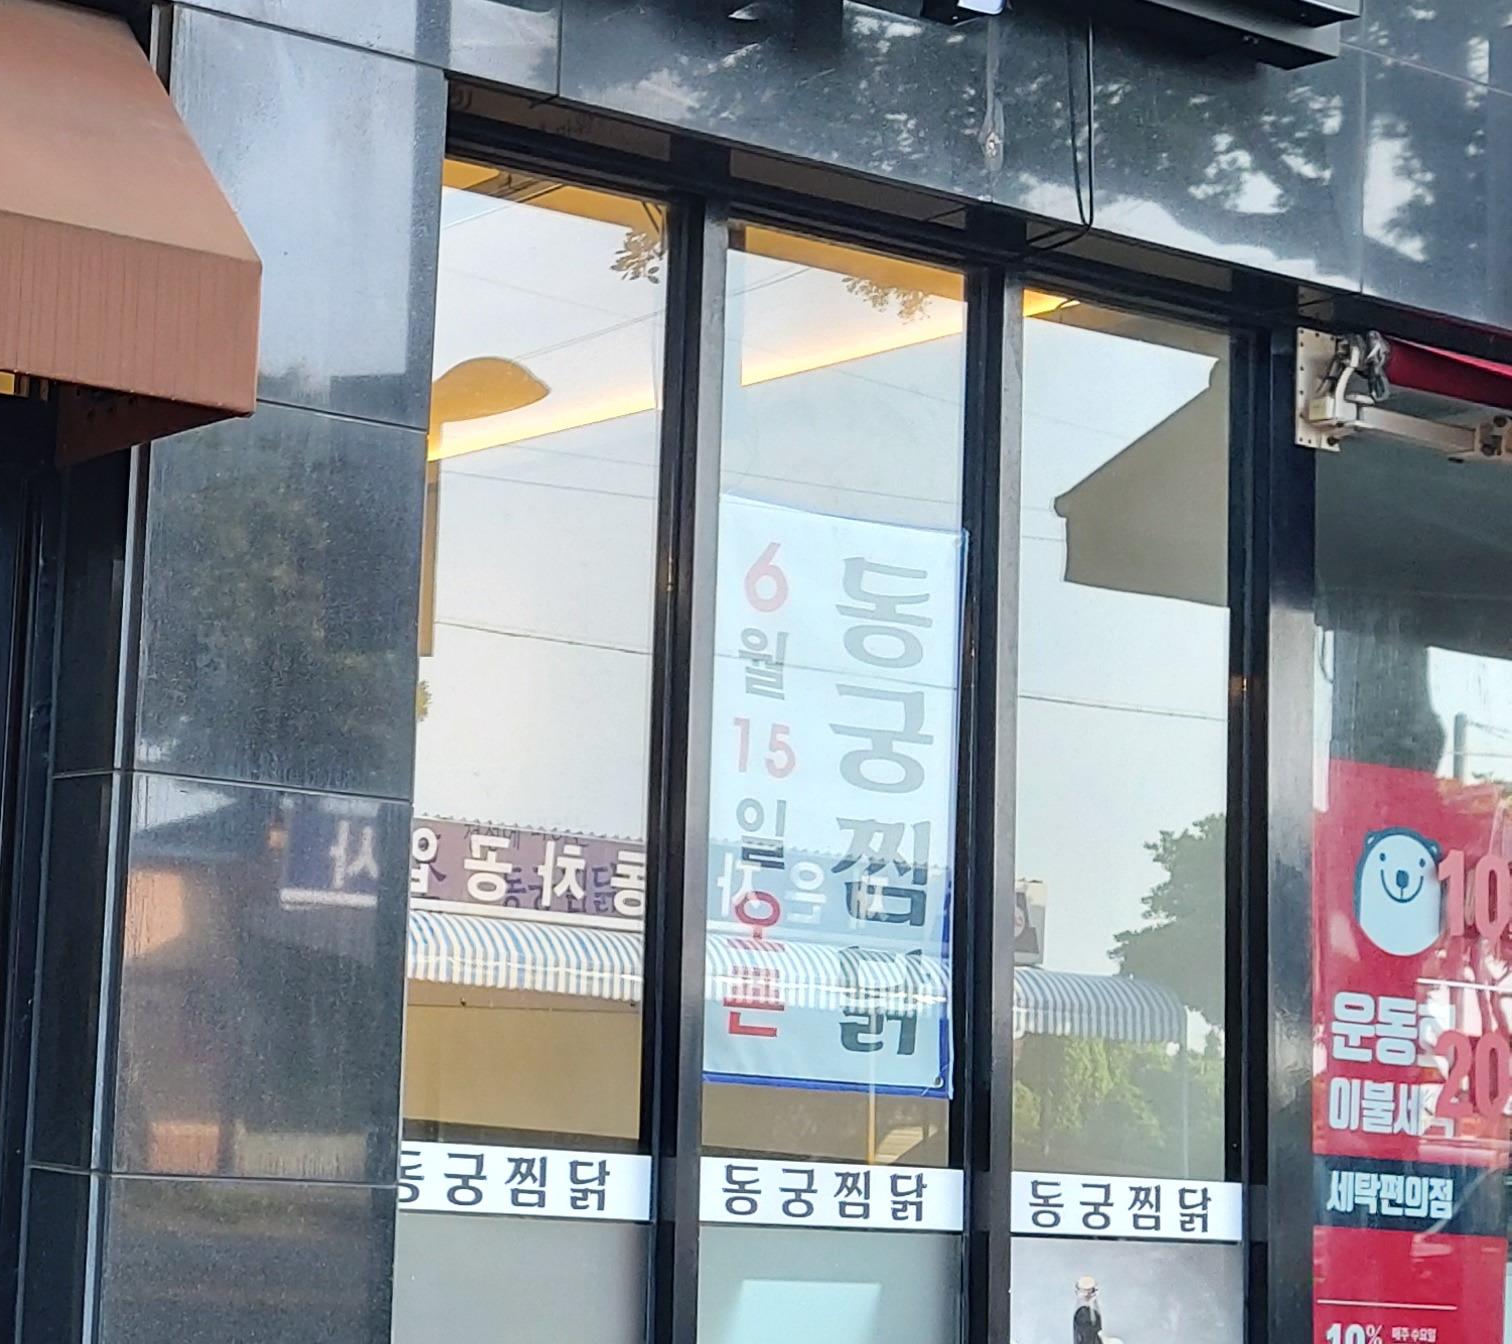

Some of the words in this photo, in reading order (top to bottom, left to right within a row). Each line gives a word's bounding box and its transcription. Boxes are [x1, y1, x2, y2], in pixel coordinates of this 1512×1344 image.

[829, 555, 935, 1057] 동궁찜닭
[720, 1163, 928, 1223] 동궁찜닭
[1027, 1178, 1212, 1234] 동궁찜닭
[1326, 1169, 1454, 1220] 세탁편의점
